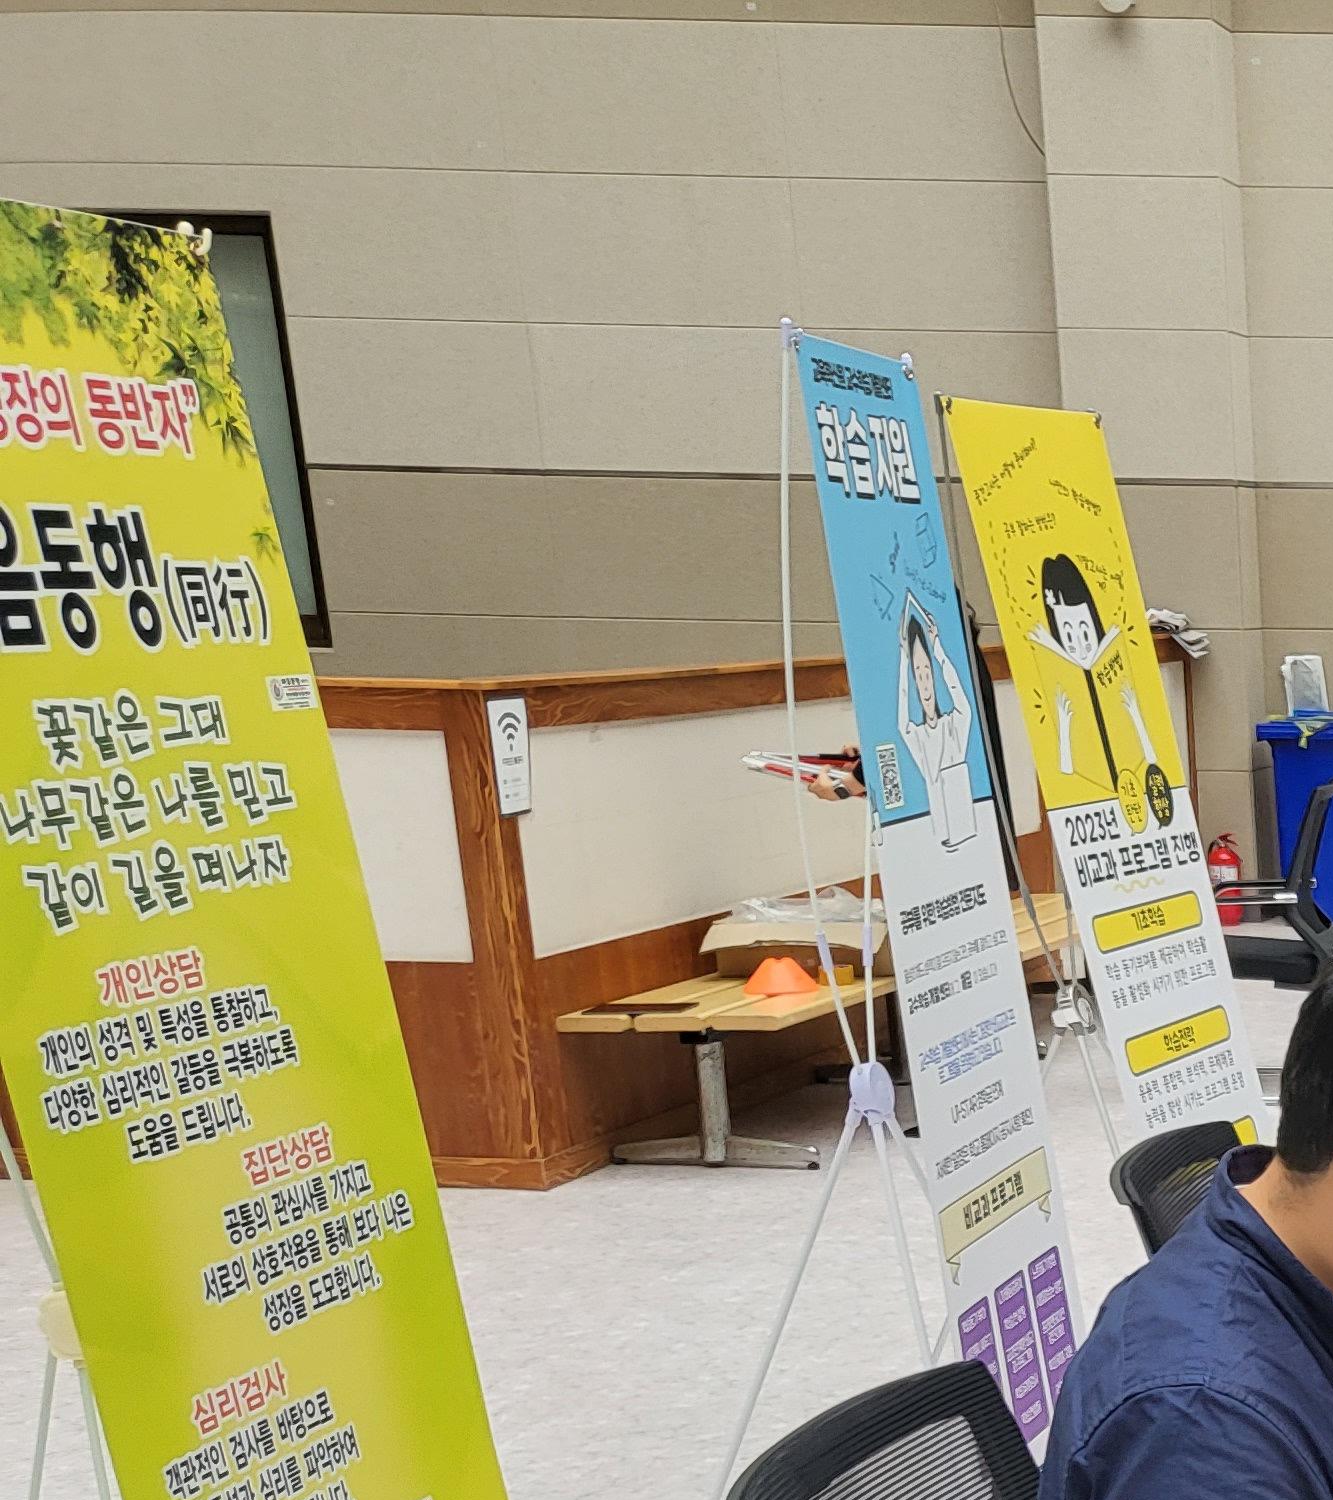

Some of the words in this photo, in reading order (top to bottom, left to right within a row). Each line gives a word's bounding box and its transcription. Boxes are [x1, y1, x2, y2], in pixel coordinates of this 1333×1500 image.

[815, 401, 922, 504] 학습지원
[35, 692, 151, 767] 꽃같은
[159, 700, 228, 743] 그대
[0, 772, 147, 846] 나무같은
[151, 766, 226, 829] 나를
[226, 765, 295, 821] 믿고
[1065, 807, 1121, 847] 2023년
[26, 864, 107, 931] 같이
[111, 845, 190, 916] 길을
[190, 840, 290, 889] 떠나자
[1074, 847, 1119, 889] 비교과
[1118, 838, 1172, 877] 프로그램
[1172, 831, 1201, 866] 진행
[1130, 907, 1167, 932] 기초학습
[97, 949, 205, 1004] 개인상담
[40, 1024, 97, 1076] 개인의
[98, 1016, 137, 1061] 성격
[136, 1010, 158, 1052] 및
[159, 999, 207, 1046] 특성을
[210, 986, 279, 1037] 통찰하고,
[1163, 1025, 1195, 1053] 학습전략
[42, 1082, 99, 1132] 다양한
[101, 1061, 171, 1116] 심리적인
[171, 1049, 223, 1098] 갈등을
[222, 1028, 300, 1079] 극복하도록
[127, 1111, 181, 1162] 도움을
[243, 1126, 334, 1187] 집단상담
[222, 1203, 270, 1246] 공통의
[272, 1174, 330, 1226] 관심사를
[330, 1162, 373, 1203] 가지고
[202, 1257, 251, 1304] 서로의
[251, 1227, 323, 1286] 상호작용을
[322, 1214, 354, 1257] 통해
[353, 1206, 381, 1244] 보다
[382, 1192, 413, 1232] 나은
[263, 1284, 309, 1333] 성장을
[192, 1361, 288, 1436] 심리검사
[163, 1440, 230, 1499] 객관적인
[228, 1417, 276, 1468] 검사를
[275, 1390, 336, 1446] 바탕으로
[301, 1425, 361, 1480] 파악하여
